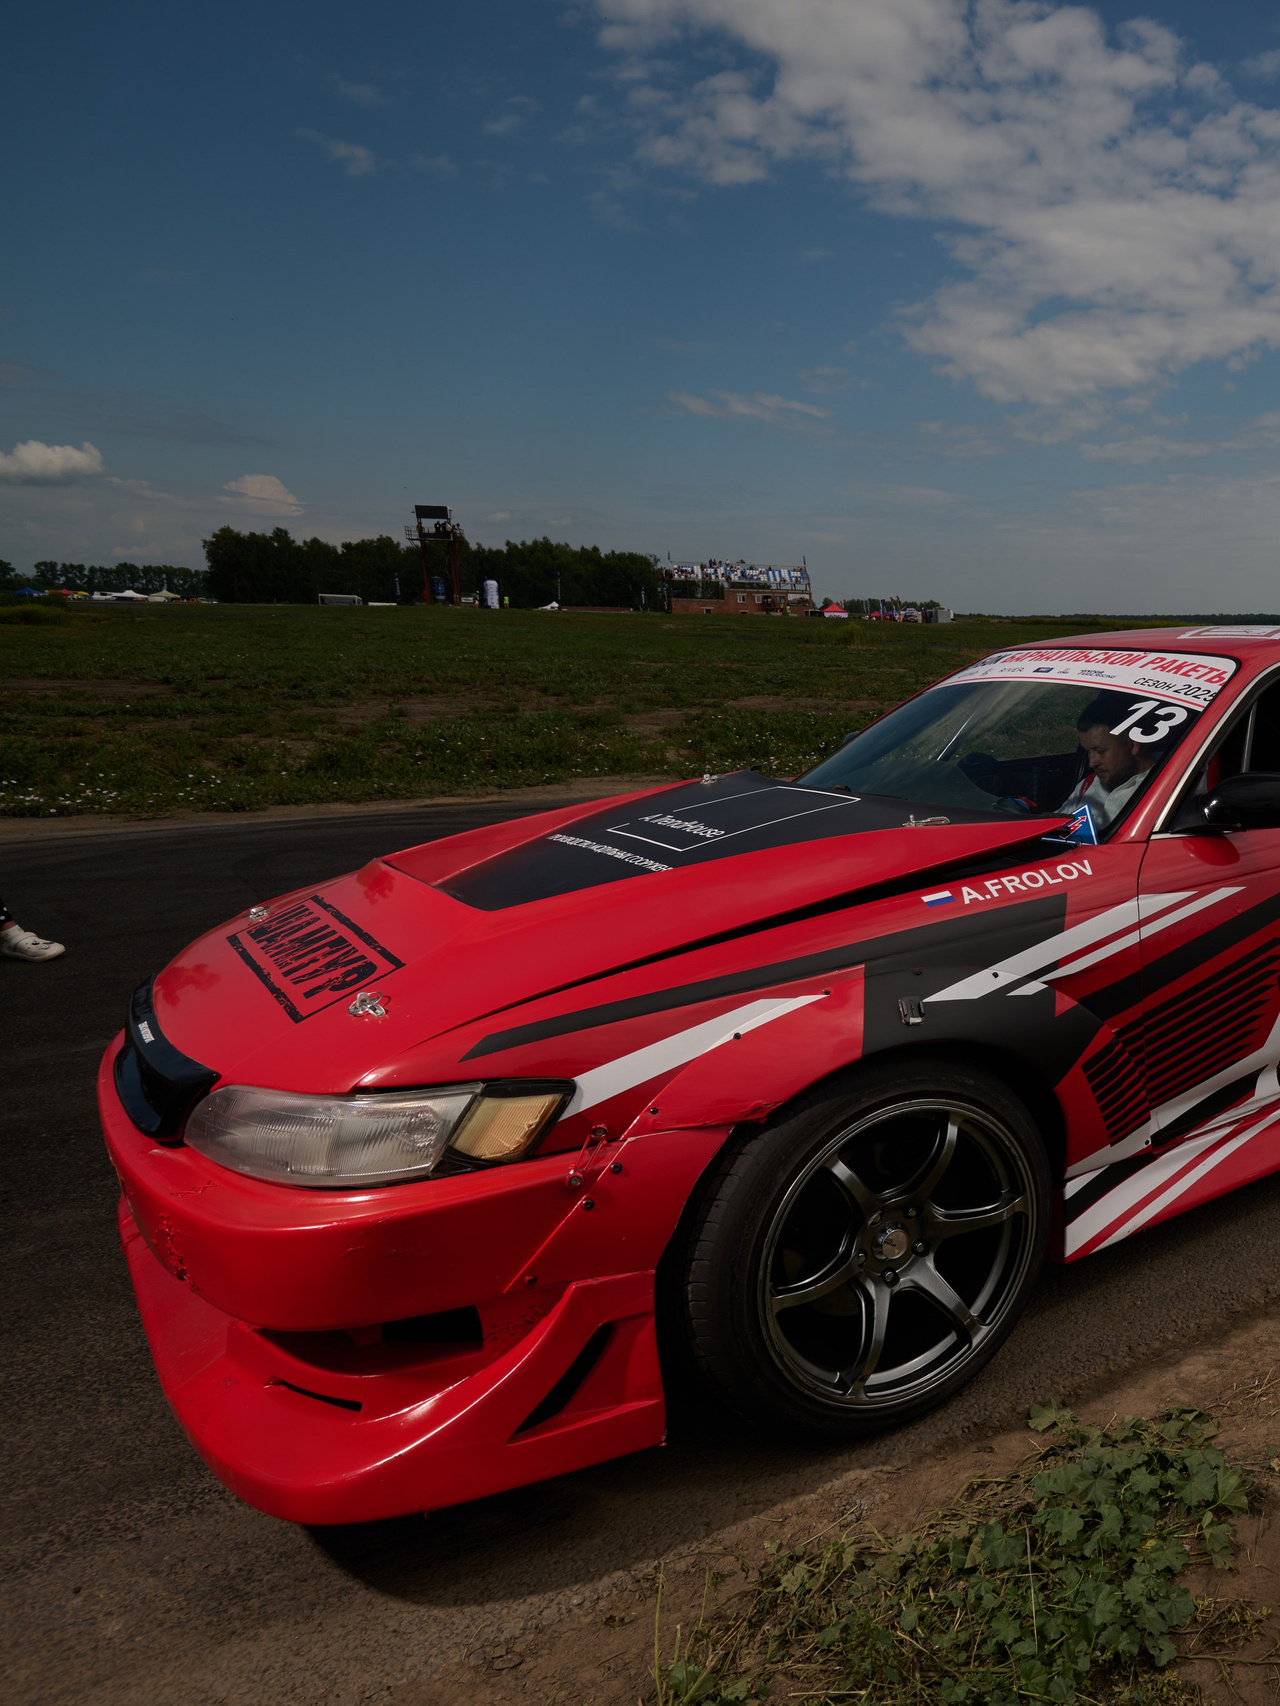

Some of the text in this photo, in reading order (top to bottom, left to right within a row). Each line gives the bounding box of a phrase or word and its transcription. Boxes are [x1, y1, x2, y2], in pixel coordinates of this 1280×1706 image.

[1133, 677, 1216, 702] СЕЗОН 2025
[1109, 700, 1188, 744] 13
[961, 859, 1093, 905] A.FROLOV
[247, 904, 378, 999] ШАМПУР
